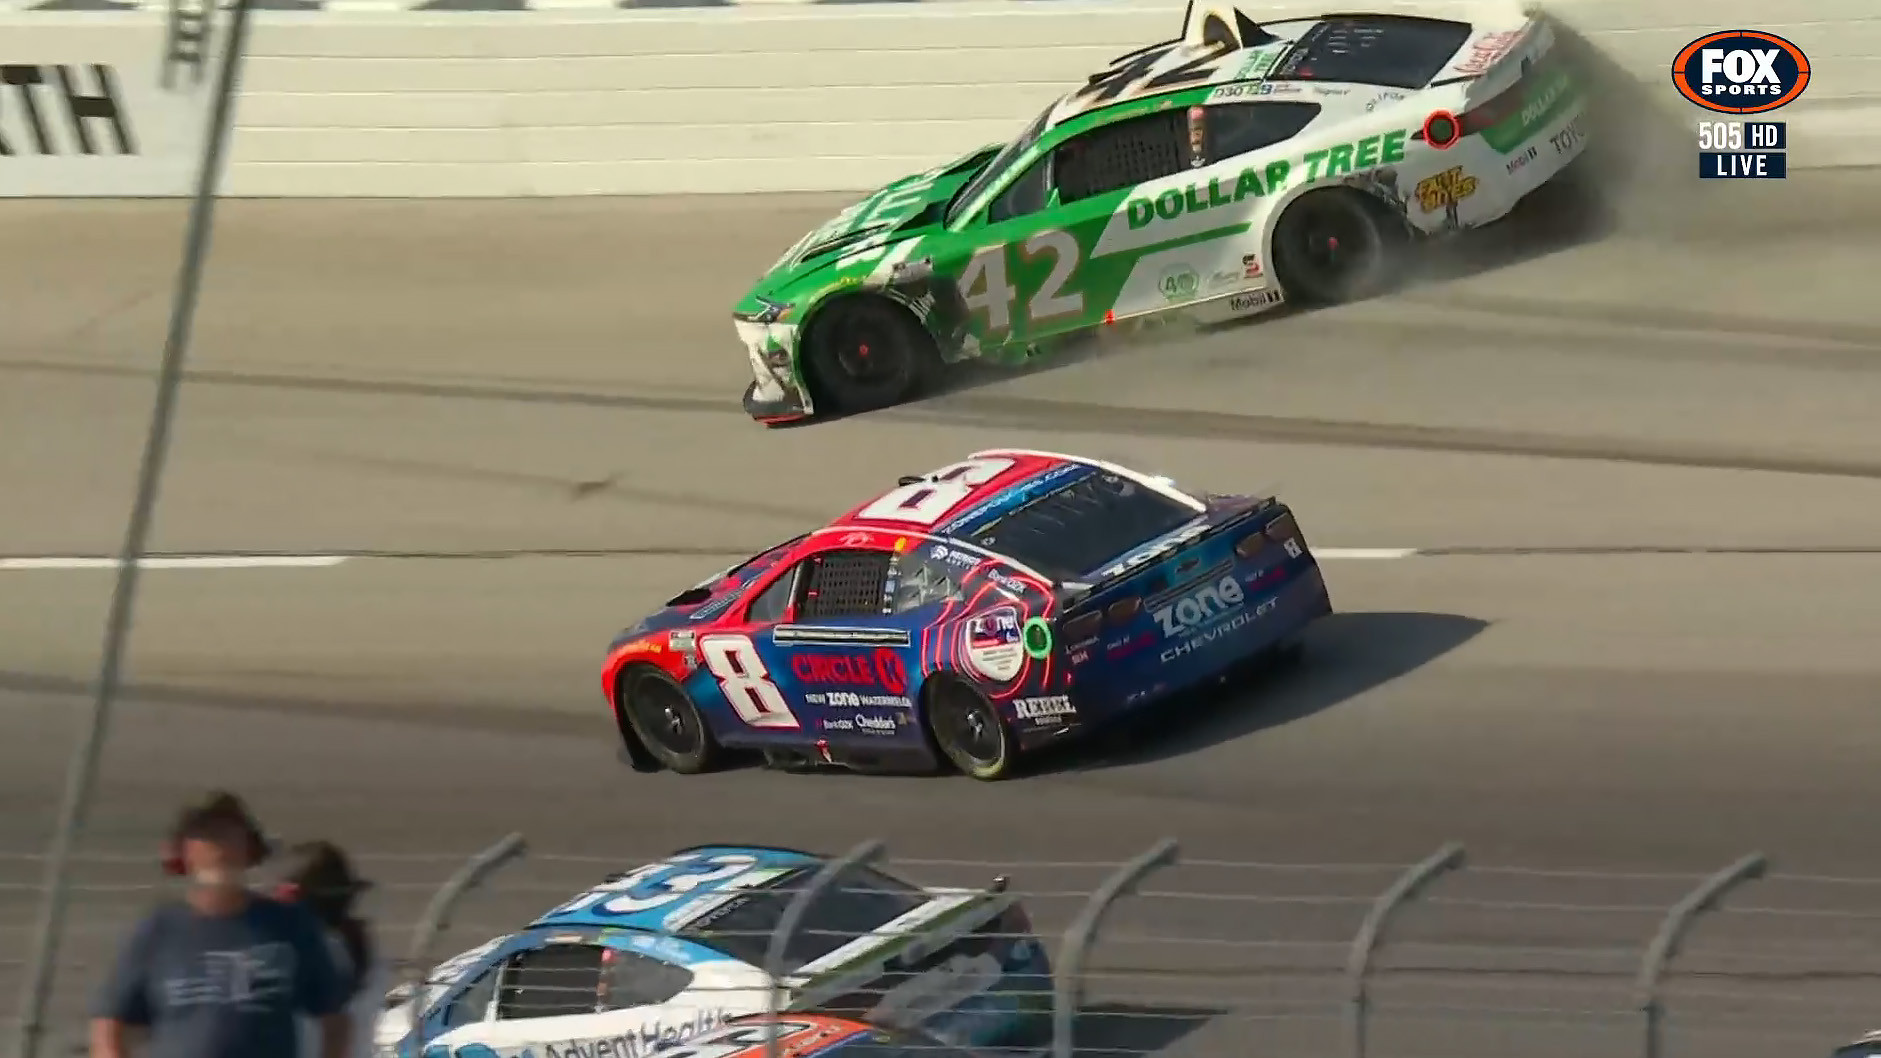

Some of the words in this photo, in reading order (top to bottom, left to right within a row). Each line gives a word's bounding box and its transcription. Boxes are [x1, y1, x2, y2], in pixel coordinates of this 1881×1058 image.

[0, 64, 140, 155] TH
[1127, 160, 1291, 231] DOLLAR
[1303, 129, 1407, 184] TREE
[957, 229, 1084, 331] 42
[857, 454, 1016, 525] 8
[1284, 538, 1303, 559] 8
[1153, 575, 1244, 639] zone
[1160, 597, 1279, 663] CHEVROLET
[701, 634, 799, 727] 8
[793, 653, 874, 685] CIRCLE
[826, 692, 860, 707] zone
[1013, 695, 1076, 719] REBEL
